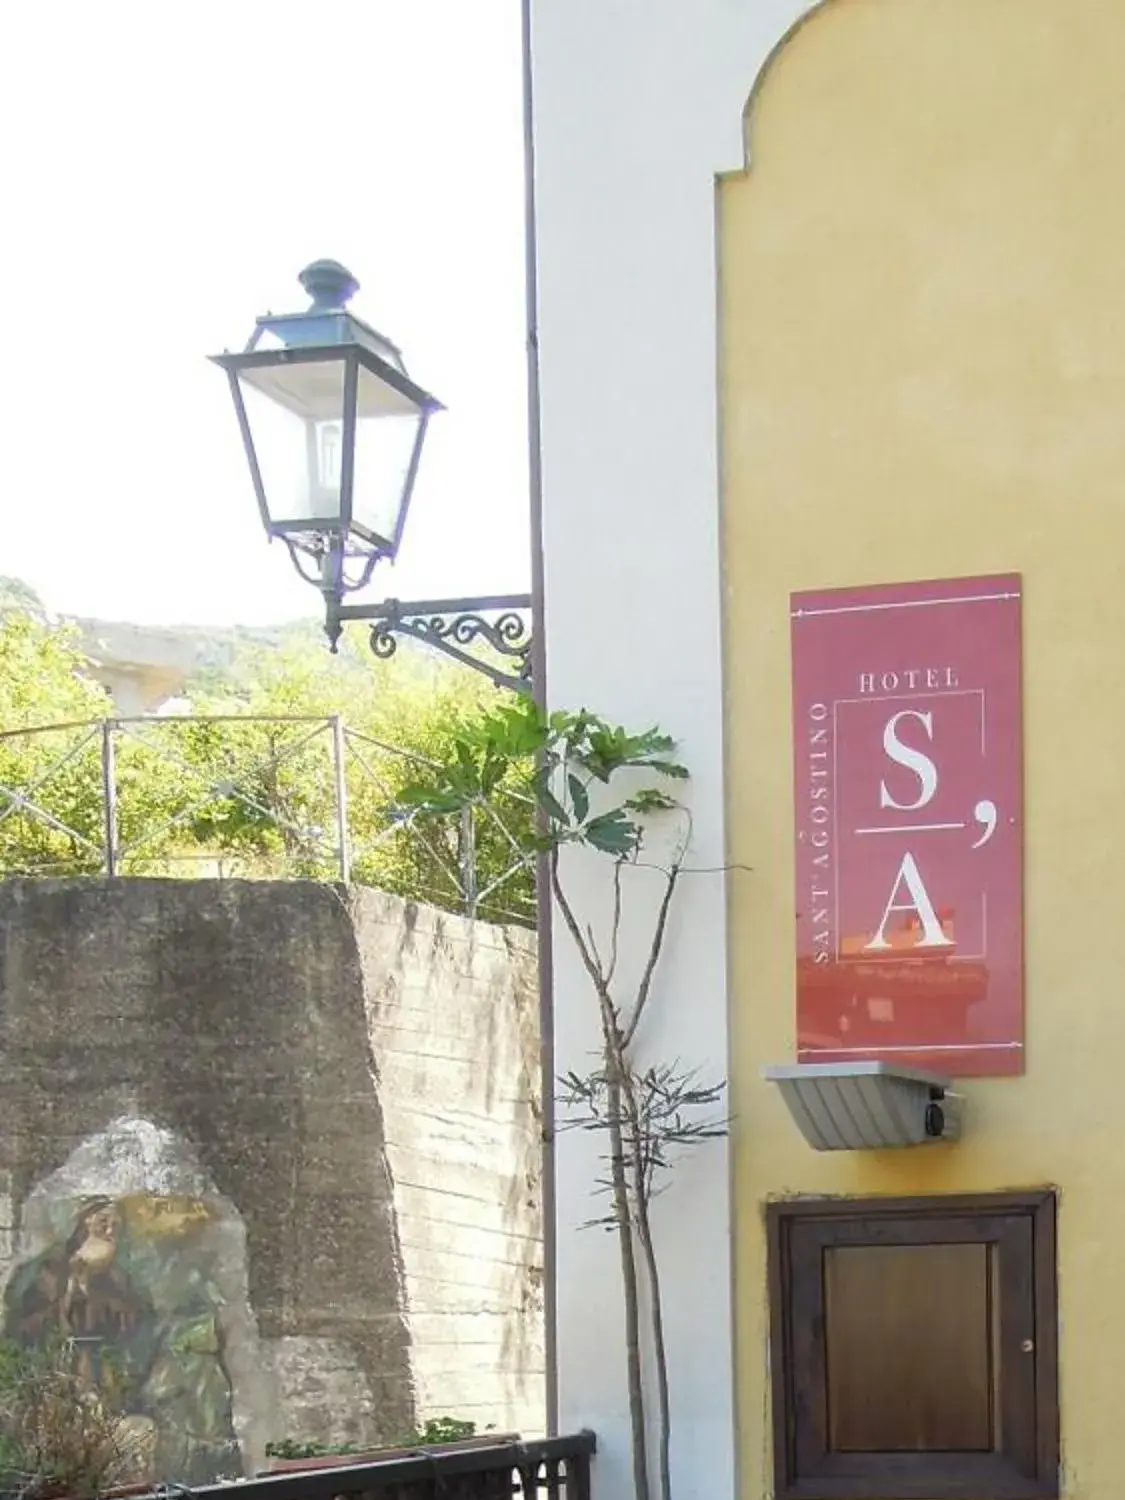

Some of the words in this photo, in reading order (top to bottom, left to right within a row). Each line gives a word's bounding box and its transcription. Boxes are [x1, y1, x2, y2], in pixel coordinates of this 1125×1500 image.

[858, 666, 960, 693] HOTEL
[880, 709, 938, 811] S
[809, 702, 829, 964] SANT'AGOSTINO
[864, 851, 957, 950] A
